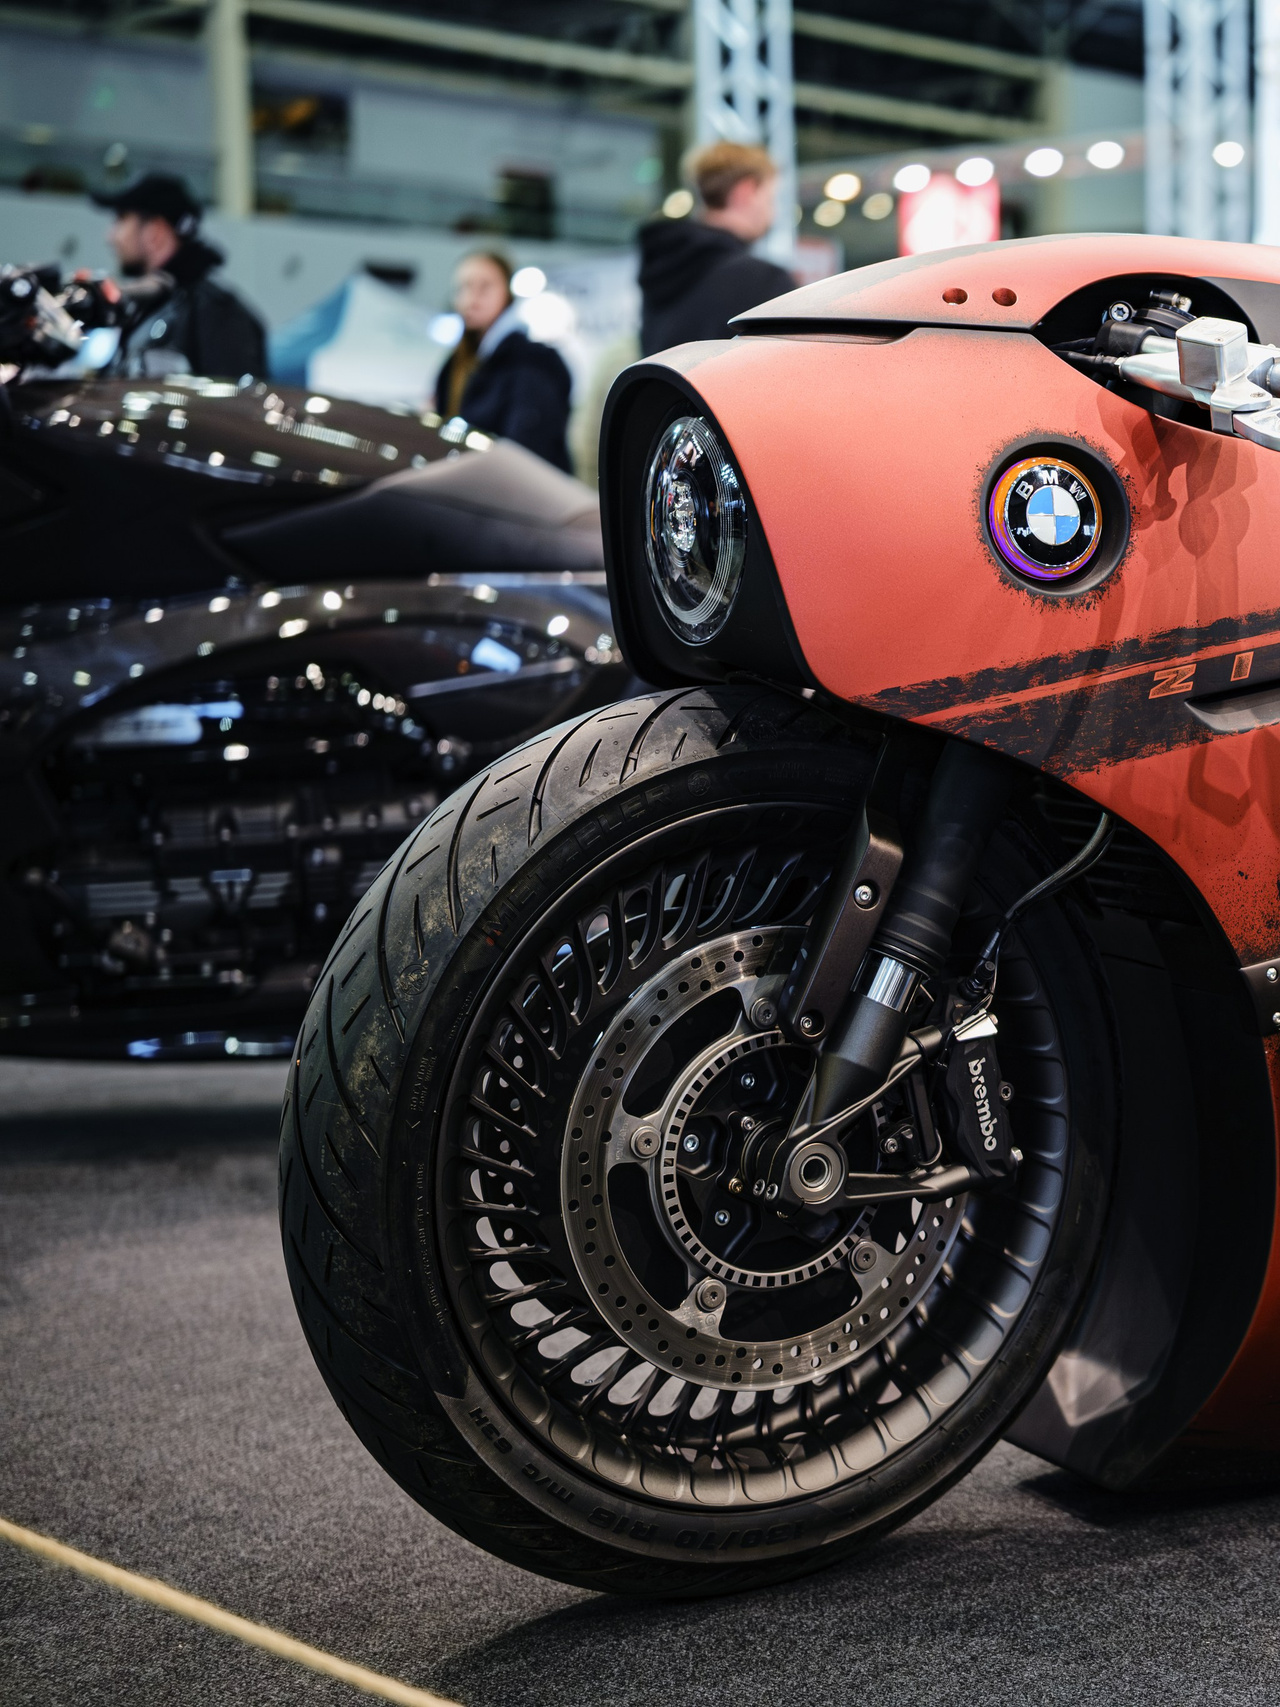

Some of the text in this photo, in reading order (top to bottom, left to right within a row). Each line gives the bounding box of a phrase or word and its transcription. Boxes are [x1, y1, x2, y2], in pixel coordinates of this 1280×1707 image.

[1015, 469, 1088, 502] BMW
[481, 783, 673, 937] METZELER
[967, 1056, 998, 1152] brembo
[467, 1405, 513, 1455] 63H
[586, 1505, 659, 1542] R18
